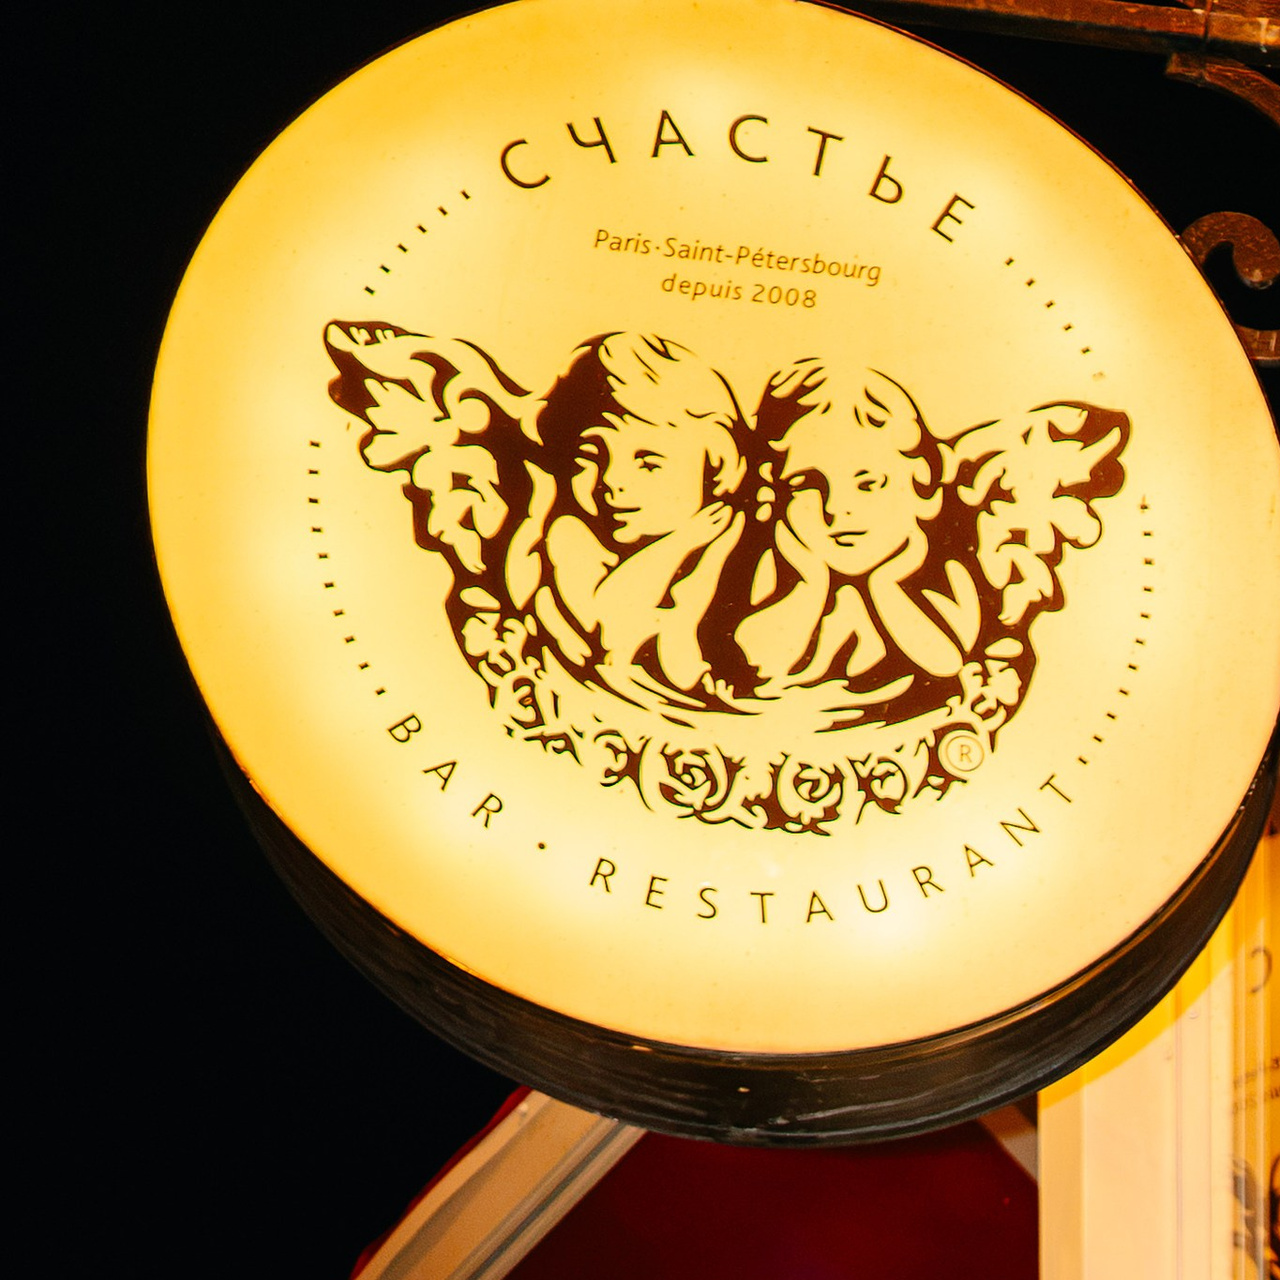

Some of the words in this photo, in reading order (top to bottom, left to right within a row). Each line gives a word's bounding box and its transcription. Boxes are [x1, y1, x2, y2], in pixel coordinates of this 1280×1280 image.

[500, 109, 977, 243] СЧАСТЬЕ
[661, 273, 742, 301] depuis
[751, 283, 817, 309] 2008
[387, 712, 506, 829] BAR
[589, 773, 1074, 925] RESTAURANT
